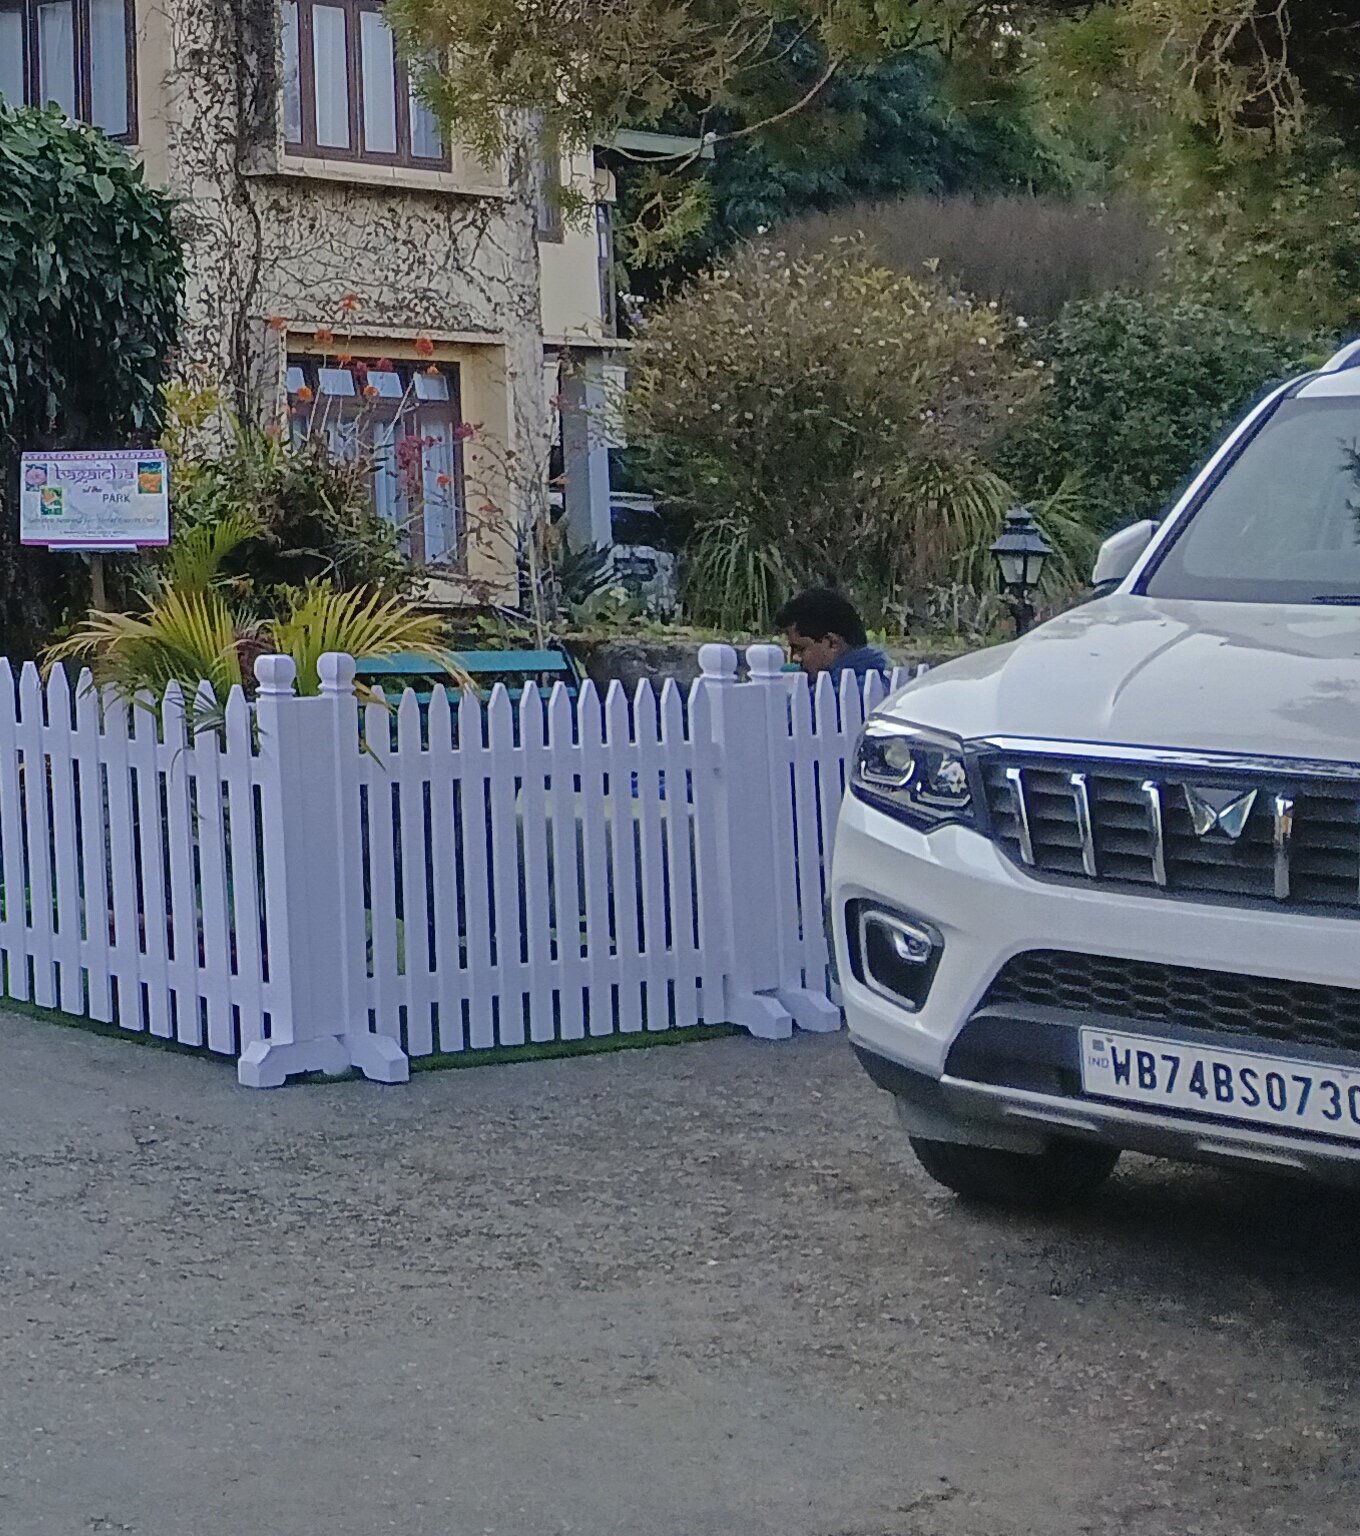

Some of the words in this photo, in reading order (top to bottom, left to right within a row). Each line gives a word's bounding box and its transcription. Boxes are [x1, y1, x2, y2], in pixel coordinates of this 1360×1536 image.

[53, 463, 135, 484] bagaicha
[102, 493, 131, 503] PARK
[1088, 1056, 1110, 1068] IND
